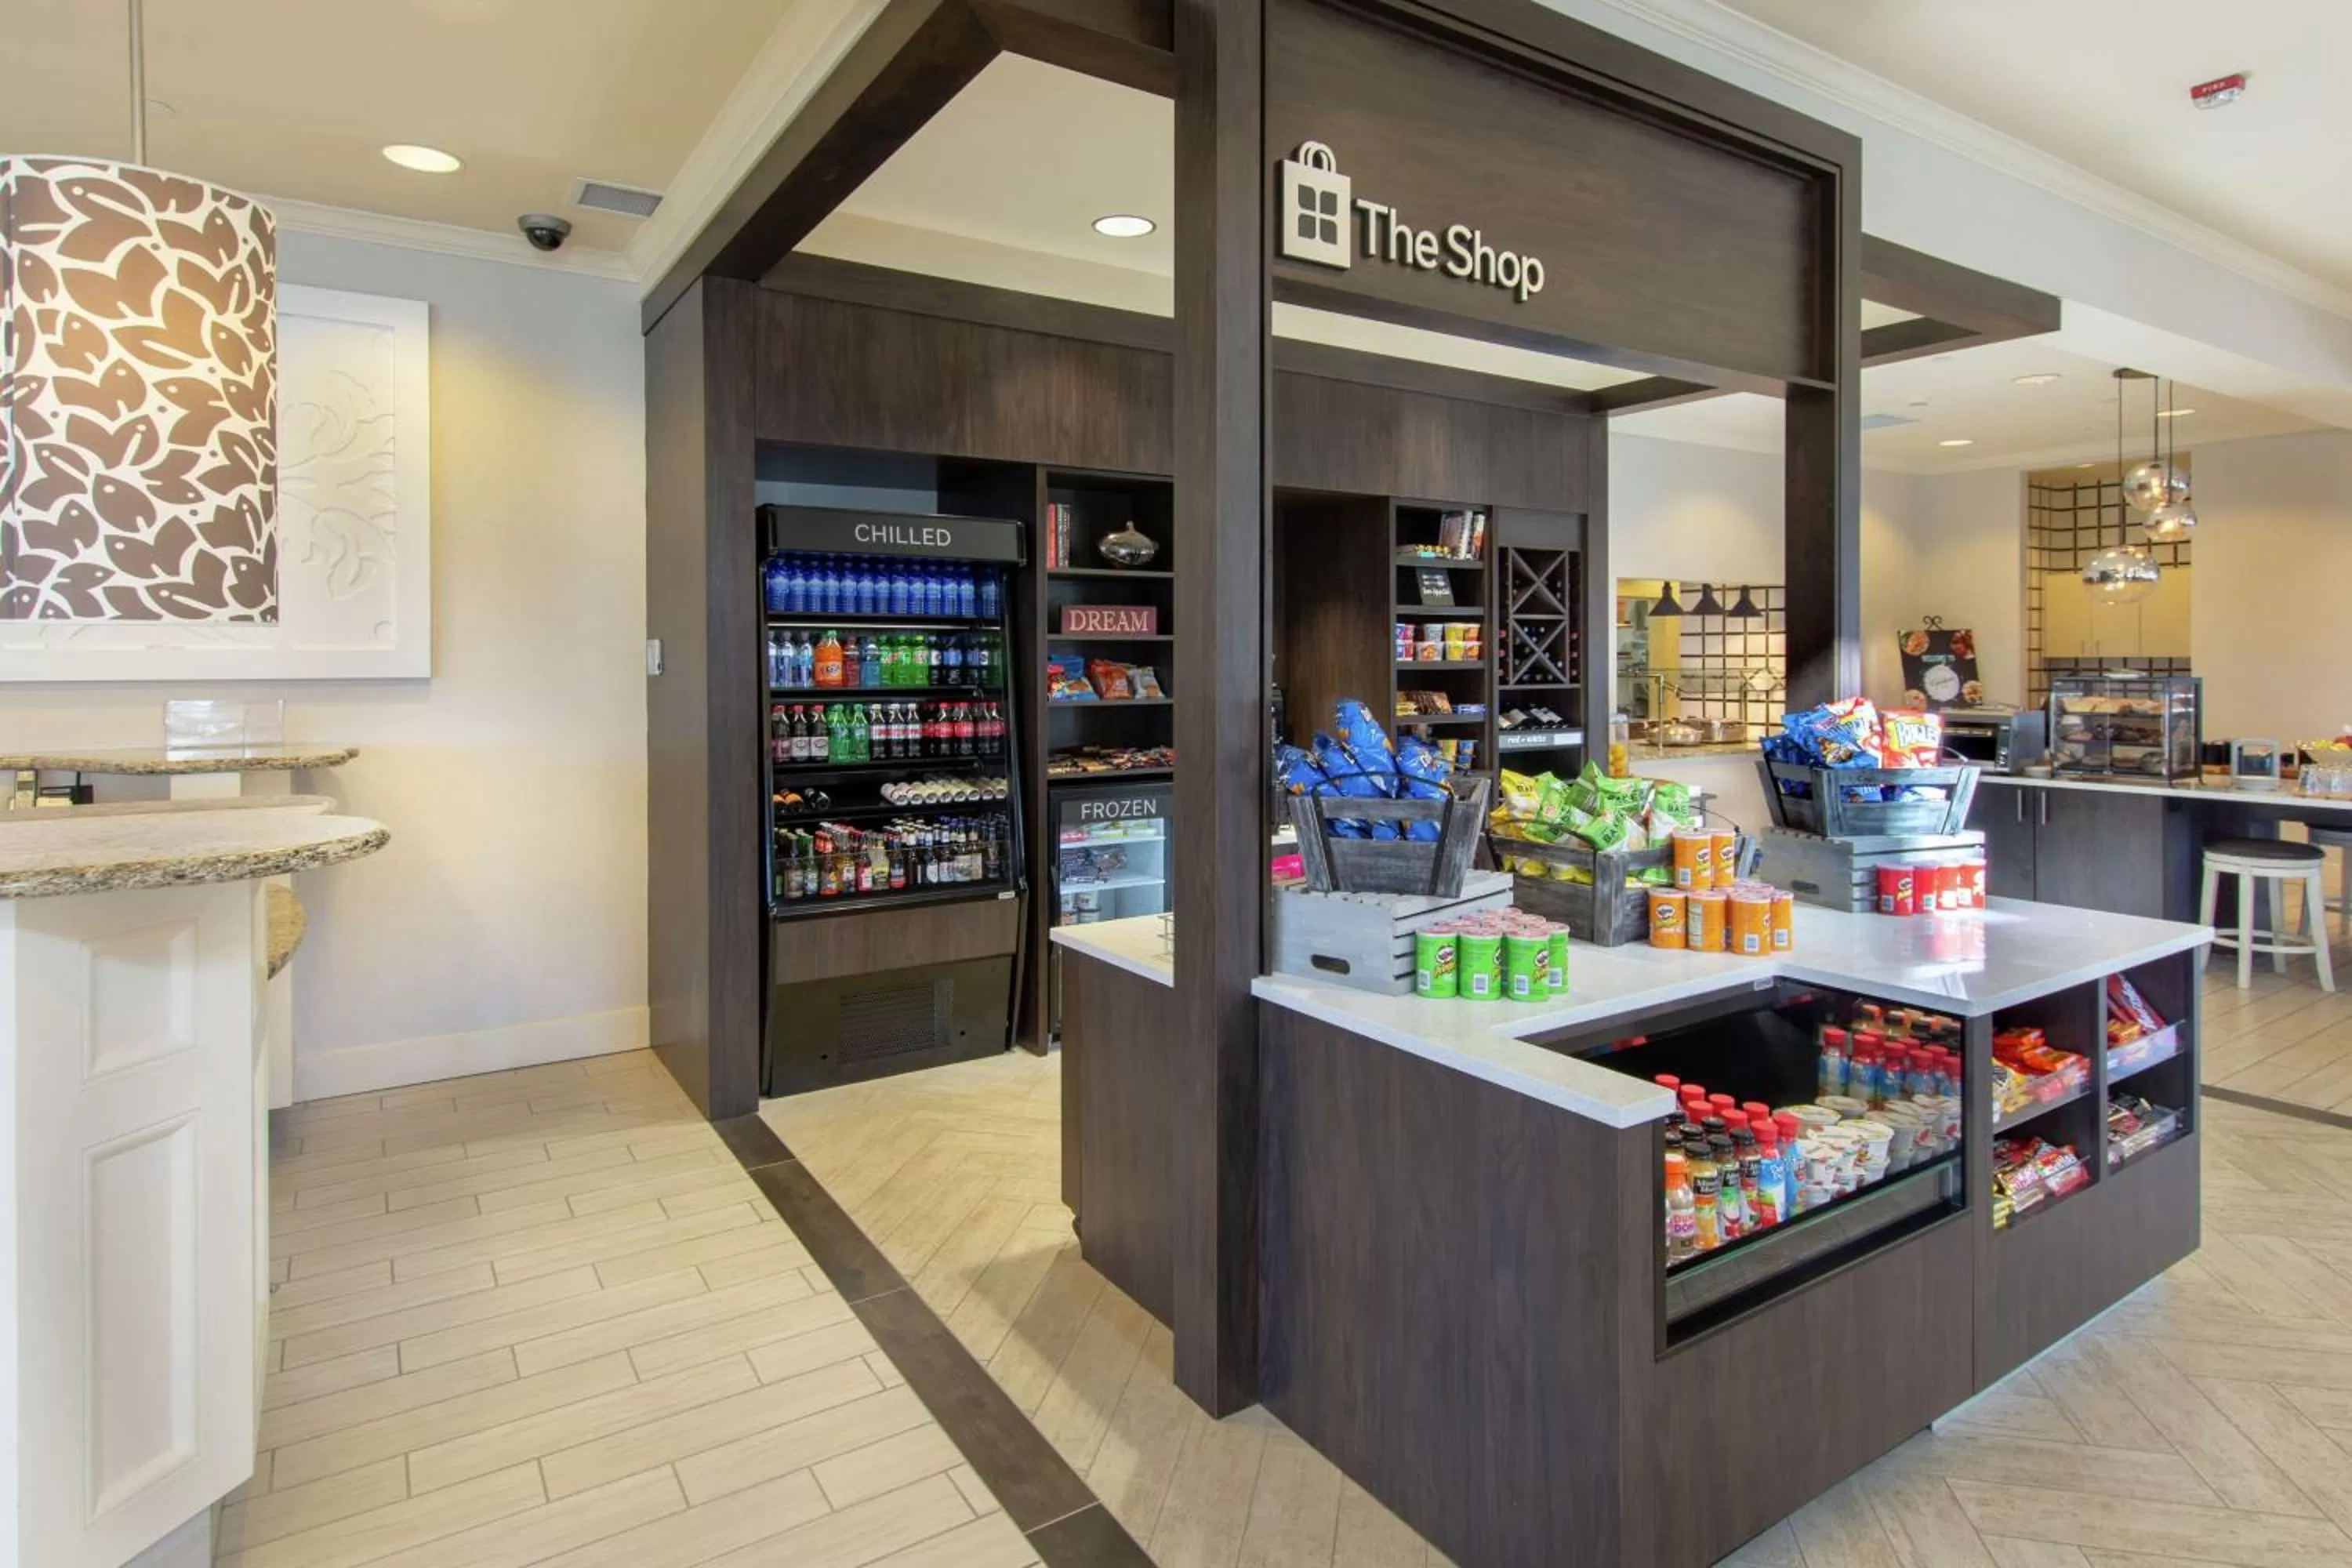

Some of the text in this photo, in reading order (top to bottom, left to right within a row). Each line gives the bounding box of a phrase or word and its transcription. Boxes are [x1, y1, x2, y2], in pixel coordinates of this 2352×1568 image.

[1356, 198, 1545, 302] The Shop
[855, 523, 952, 546] CHILLED
[1069, 609, 1149, 631] DREAM
[1896, 720, 1939, 747] BUGLES
[1080, 799, 1157, 820] FROZEN
